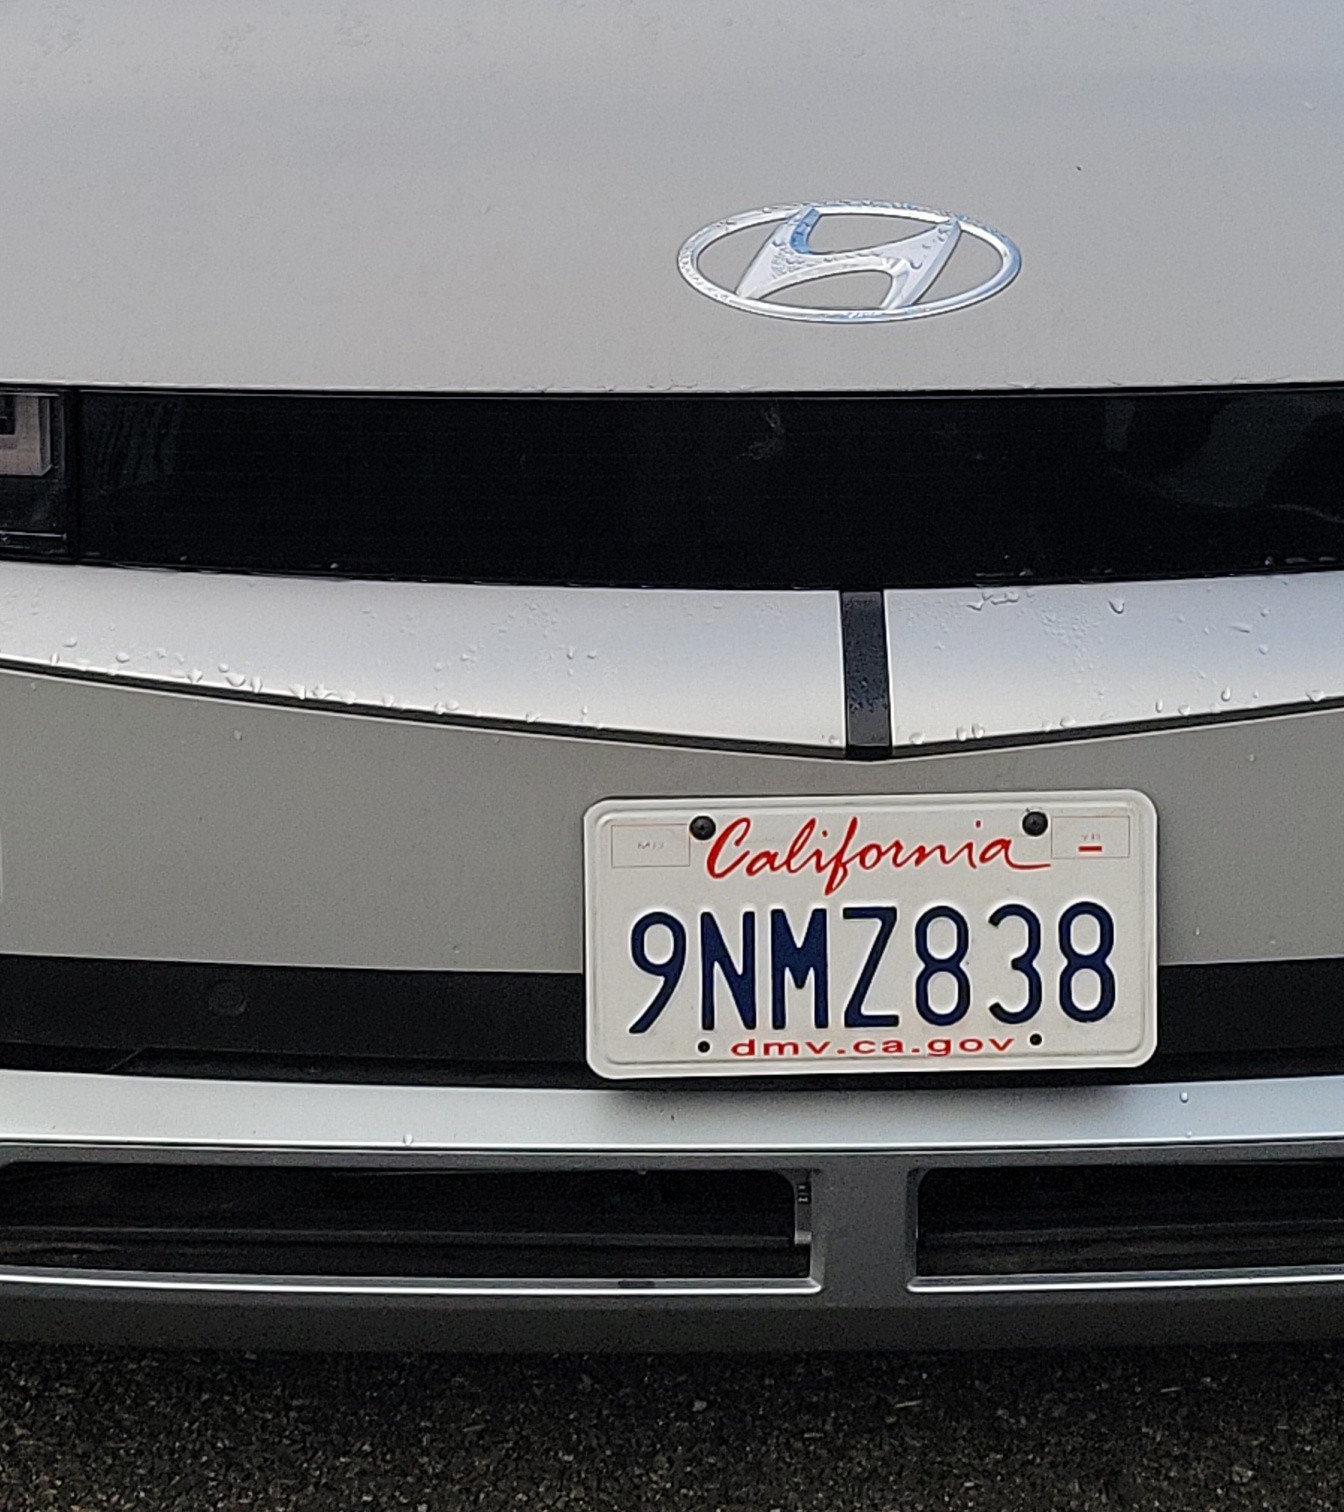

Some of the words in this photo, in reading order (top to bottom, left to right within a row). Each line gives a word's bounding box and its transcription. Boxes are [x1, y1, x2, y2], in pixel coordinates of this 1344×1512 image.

[706, 816, 1052, 896] California
[629, 900, 1116, 1034] 9NMZ838
[730, 1037, 1014, 1058] dmv.ca.gov
